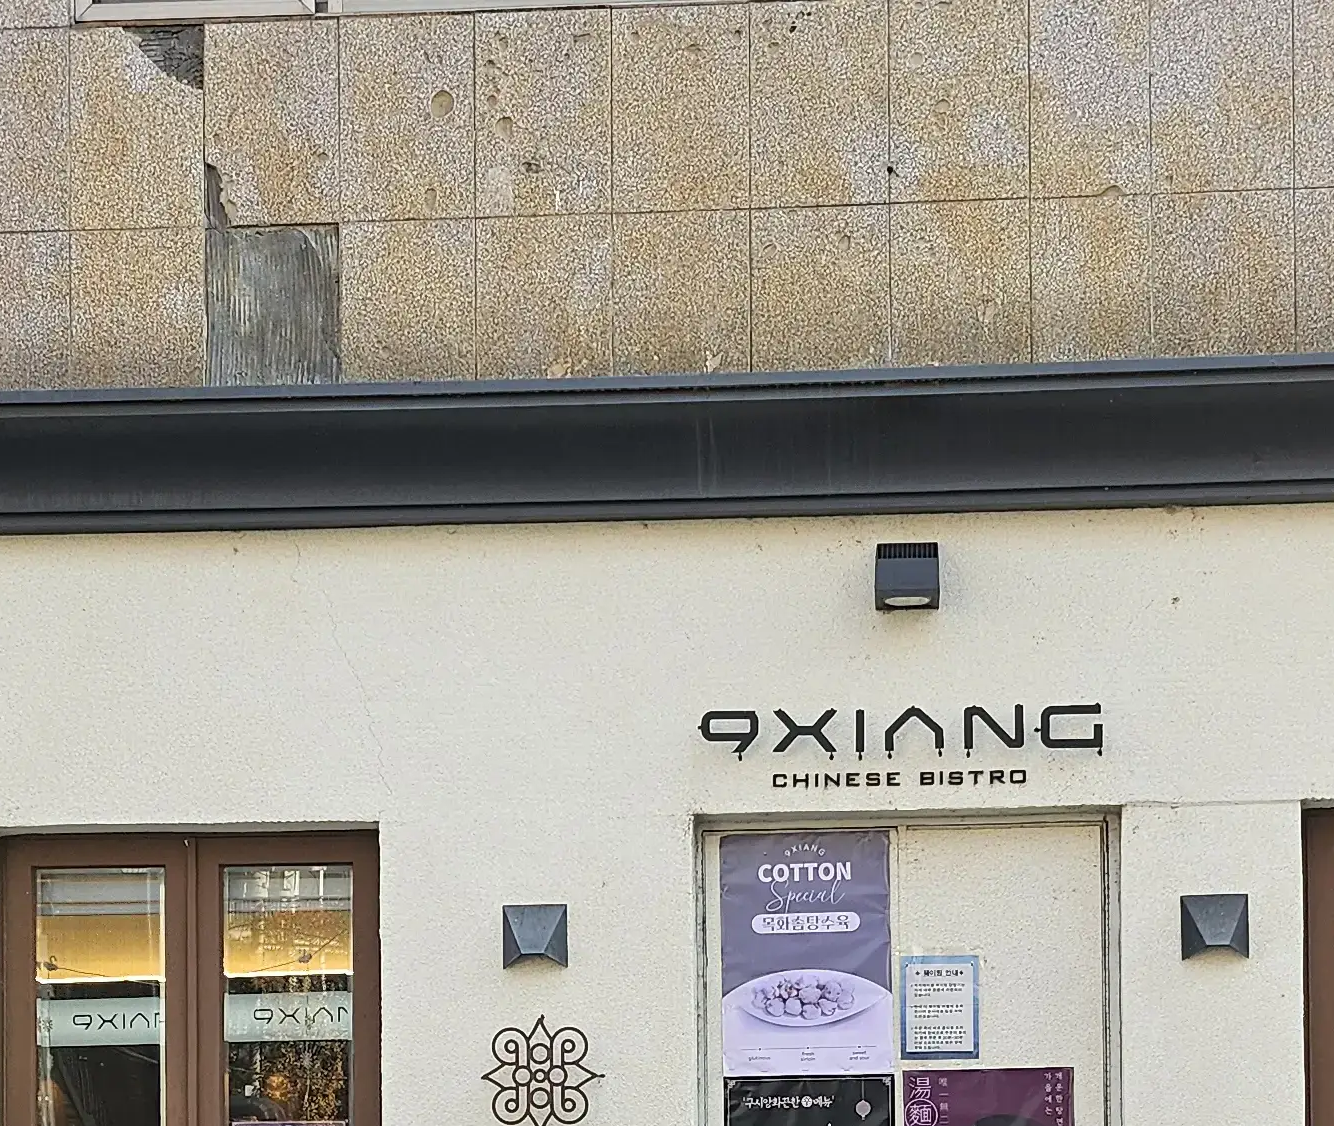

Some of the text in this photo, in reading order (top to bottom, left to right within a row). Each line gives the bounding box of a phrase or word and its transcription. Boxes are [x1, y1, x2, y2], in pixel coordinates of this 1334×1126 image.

[698, 702, 1104, 757] 9XIANG
[772, 768, 1028, 789] CHINESE BISTRO
[784, 843, 826, 857] 9XIANG
[757, 861, 852, 883] COTTON
[765, 879, 846, 914] Special
[762, 914, 850, 931] 목화솜탕수육
